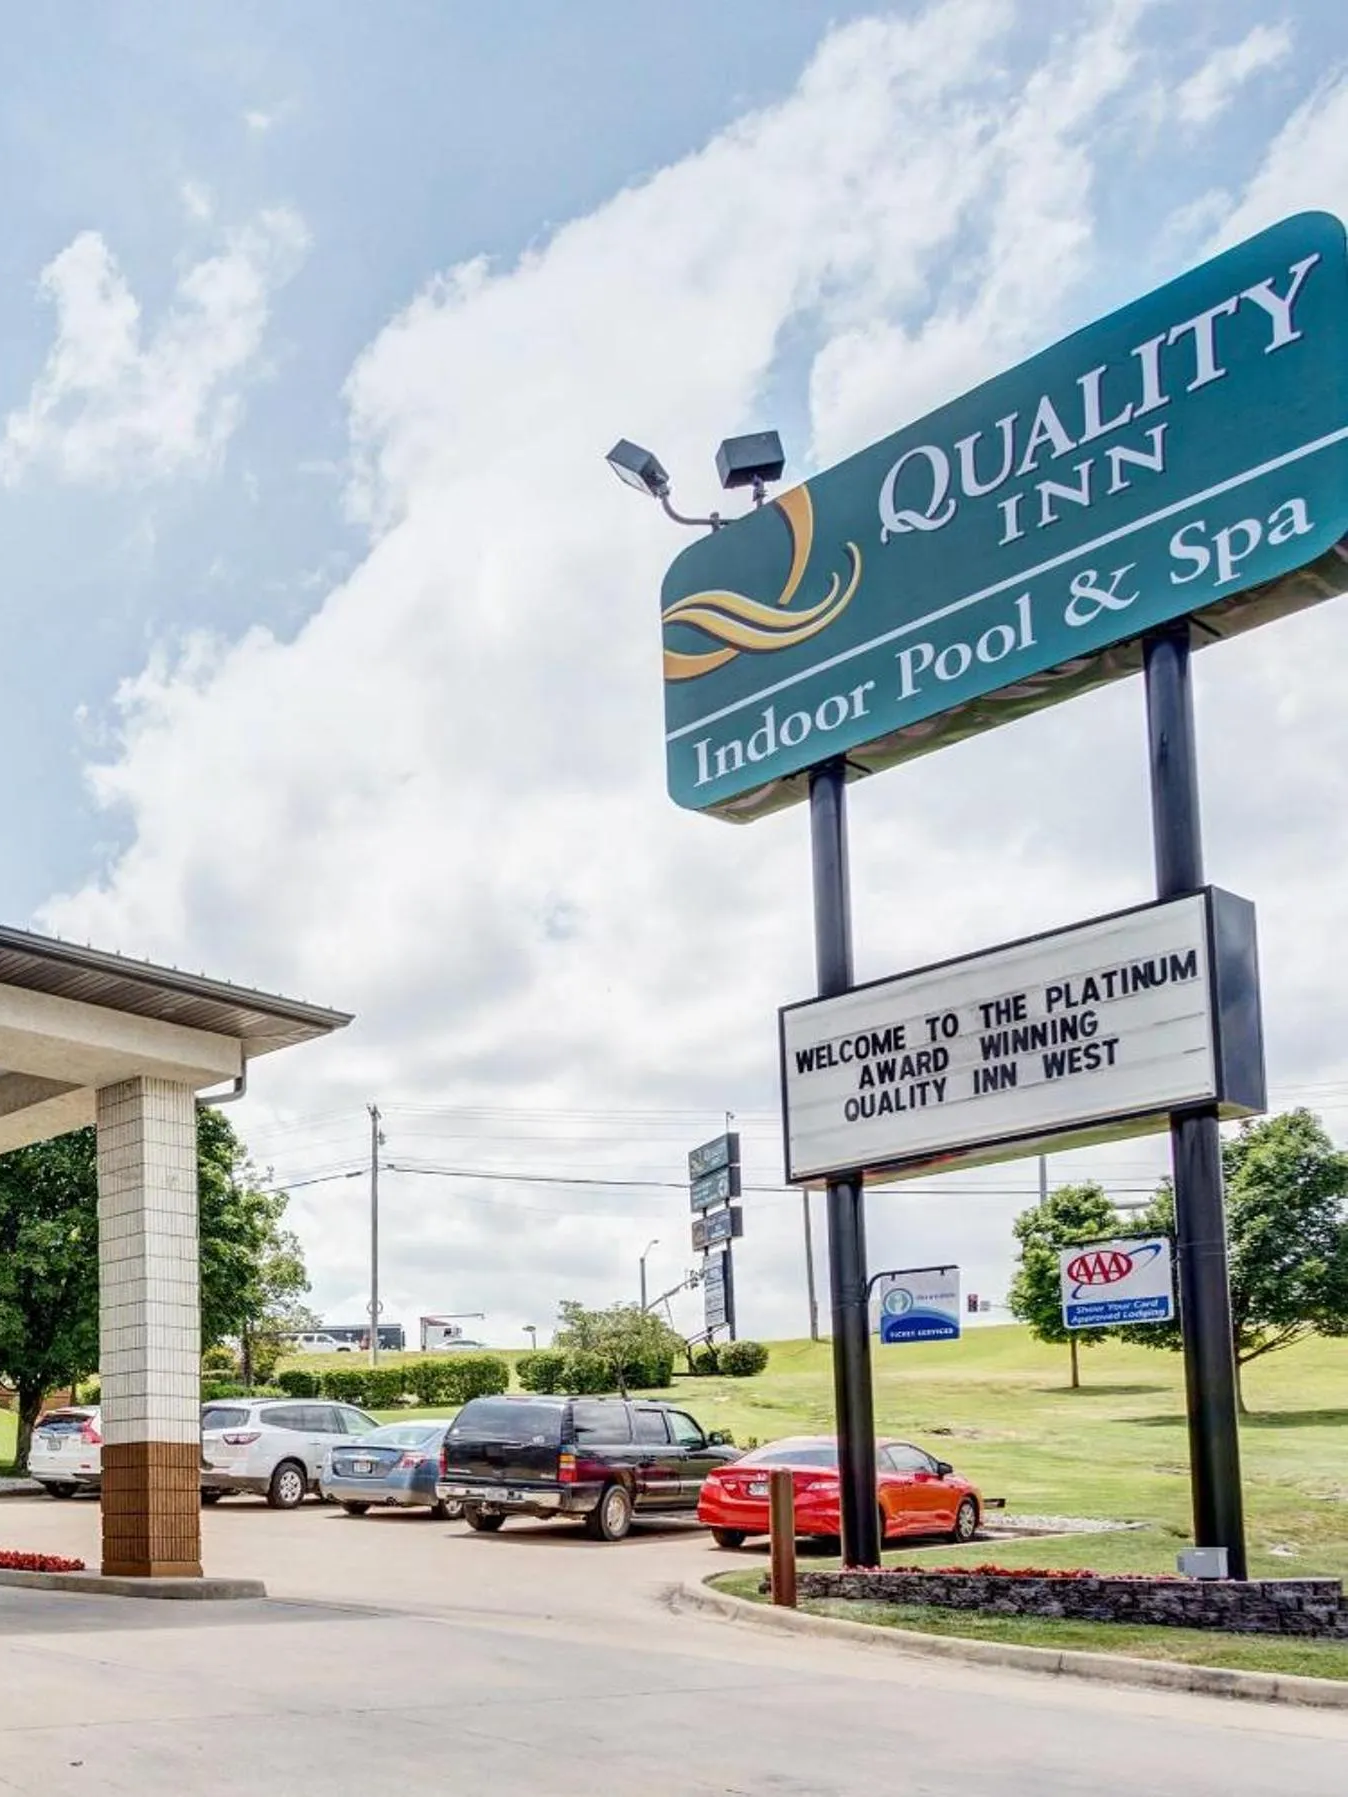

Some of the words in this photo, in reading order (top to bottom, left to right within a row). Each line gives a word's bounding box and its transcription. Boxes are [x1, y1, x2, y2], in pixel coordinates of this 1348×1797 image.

[879, 253, 1320, 545] QUALITY
[998, 423, 1169, 547] INN
[694, 679, 874, 787] Indoor
[895, 594, 1037, 702] Pool
[1064, 562, 1139, 628] &
[1169, 497, 1314, 586] Spa
[796, 1025, 905, 1074] WELCOME
[926, 1012, 959, 1043] TO
[979, 993, 1027, 1029] THE
[1045, 950, 1198, 1014] PLATINUM
[858, 1046, 949, 1090] AWARD
[979, 1009, 1099, 1060] WINNING
[973, 1062, 1017, 1095] INN
[1042, 1038, 1120, 1079] WEST
[1076, 1252, 1125, 1285] AAA
